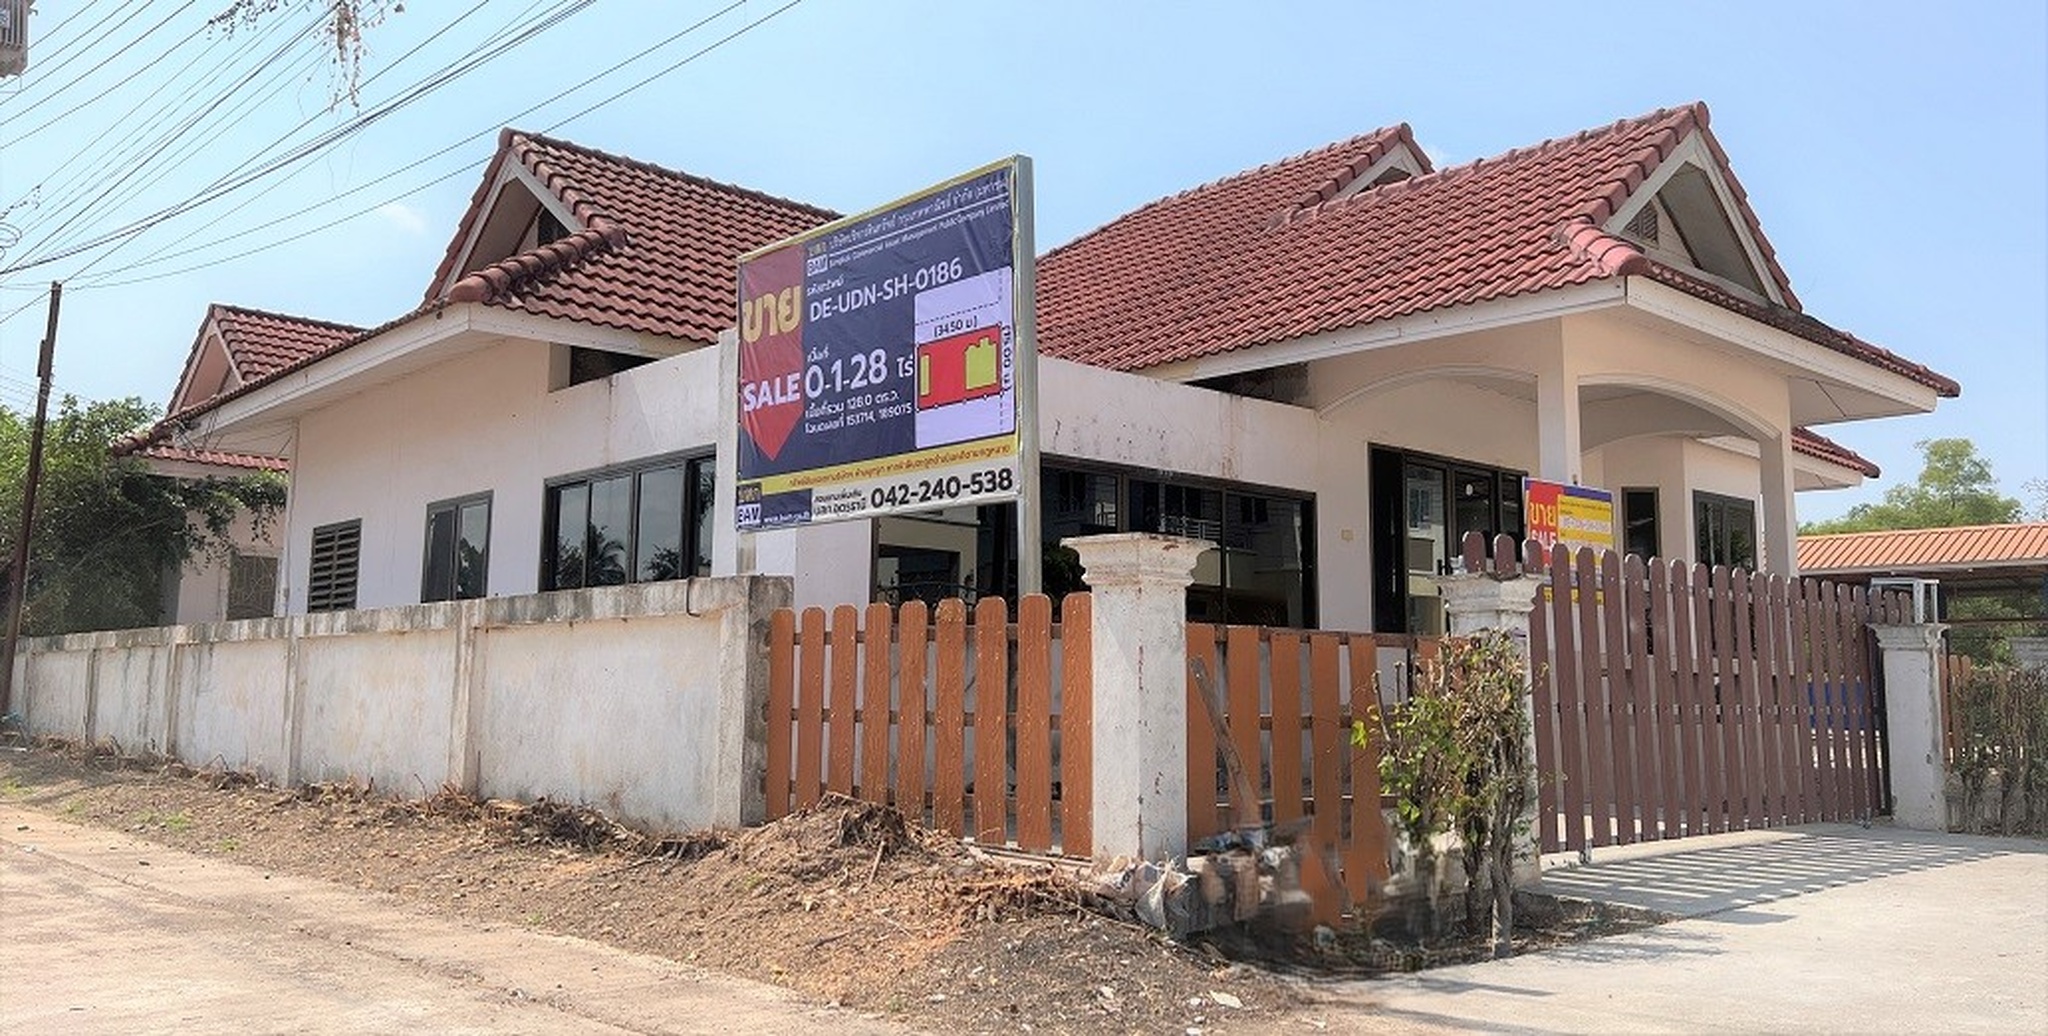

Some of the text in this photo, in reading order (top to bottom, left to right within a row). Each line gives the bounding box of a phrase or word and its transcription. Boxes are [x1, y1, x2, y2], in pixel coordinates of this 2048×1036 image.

[742, 285, 801, 343] ขาย
[810, 257, 963, 322] DE-UDN-SH-0186
[744, 372, 801, 412] SALE
[805, 348, 888, 400] 0-1-28
[871, 468, 1013, 508] 042-240-538
